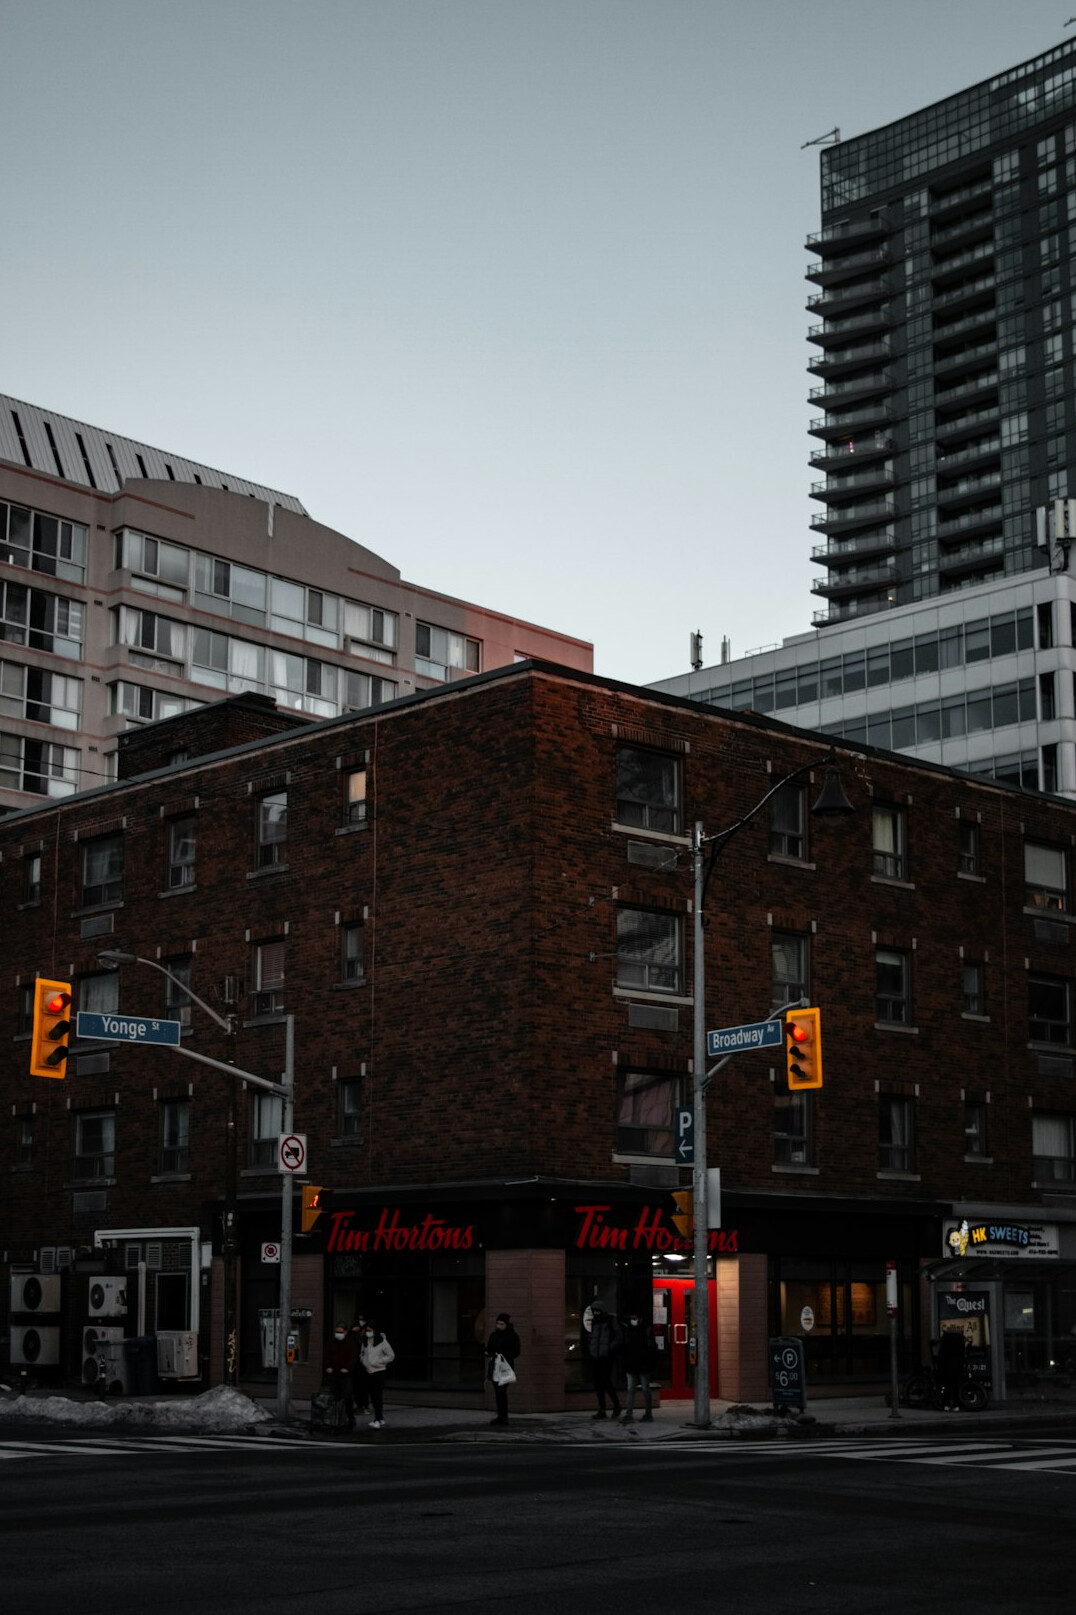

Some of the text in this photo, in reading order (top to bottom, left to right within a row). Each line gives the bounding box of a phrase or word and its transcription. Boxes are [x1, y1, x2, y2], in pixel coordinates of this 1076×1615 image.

[101, 1016, 160, 1040] Yonge St
[713, 1024, 775, 1049] Broadway Av
[679, 1111, 693, 1137] P
[326, 1207, 476, 1253] Tim Hortons
[573, 1205, 739, 1253] Tim Hons
[971, 1226, 1029, 1245] HK SWEETS
[956, 1297, 985, 1312] Quest
[786, 1352, 794, 1365] P
